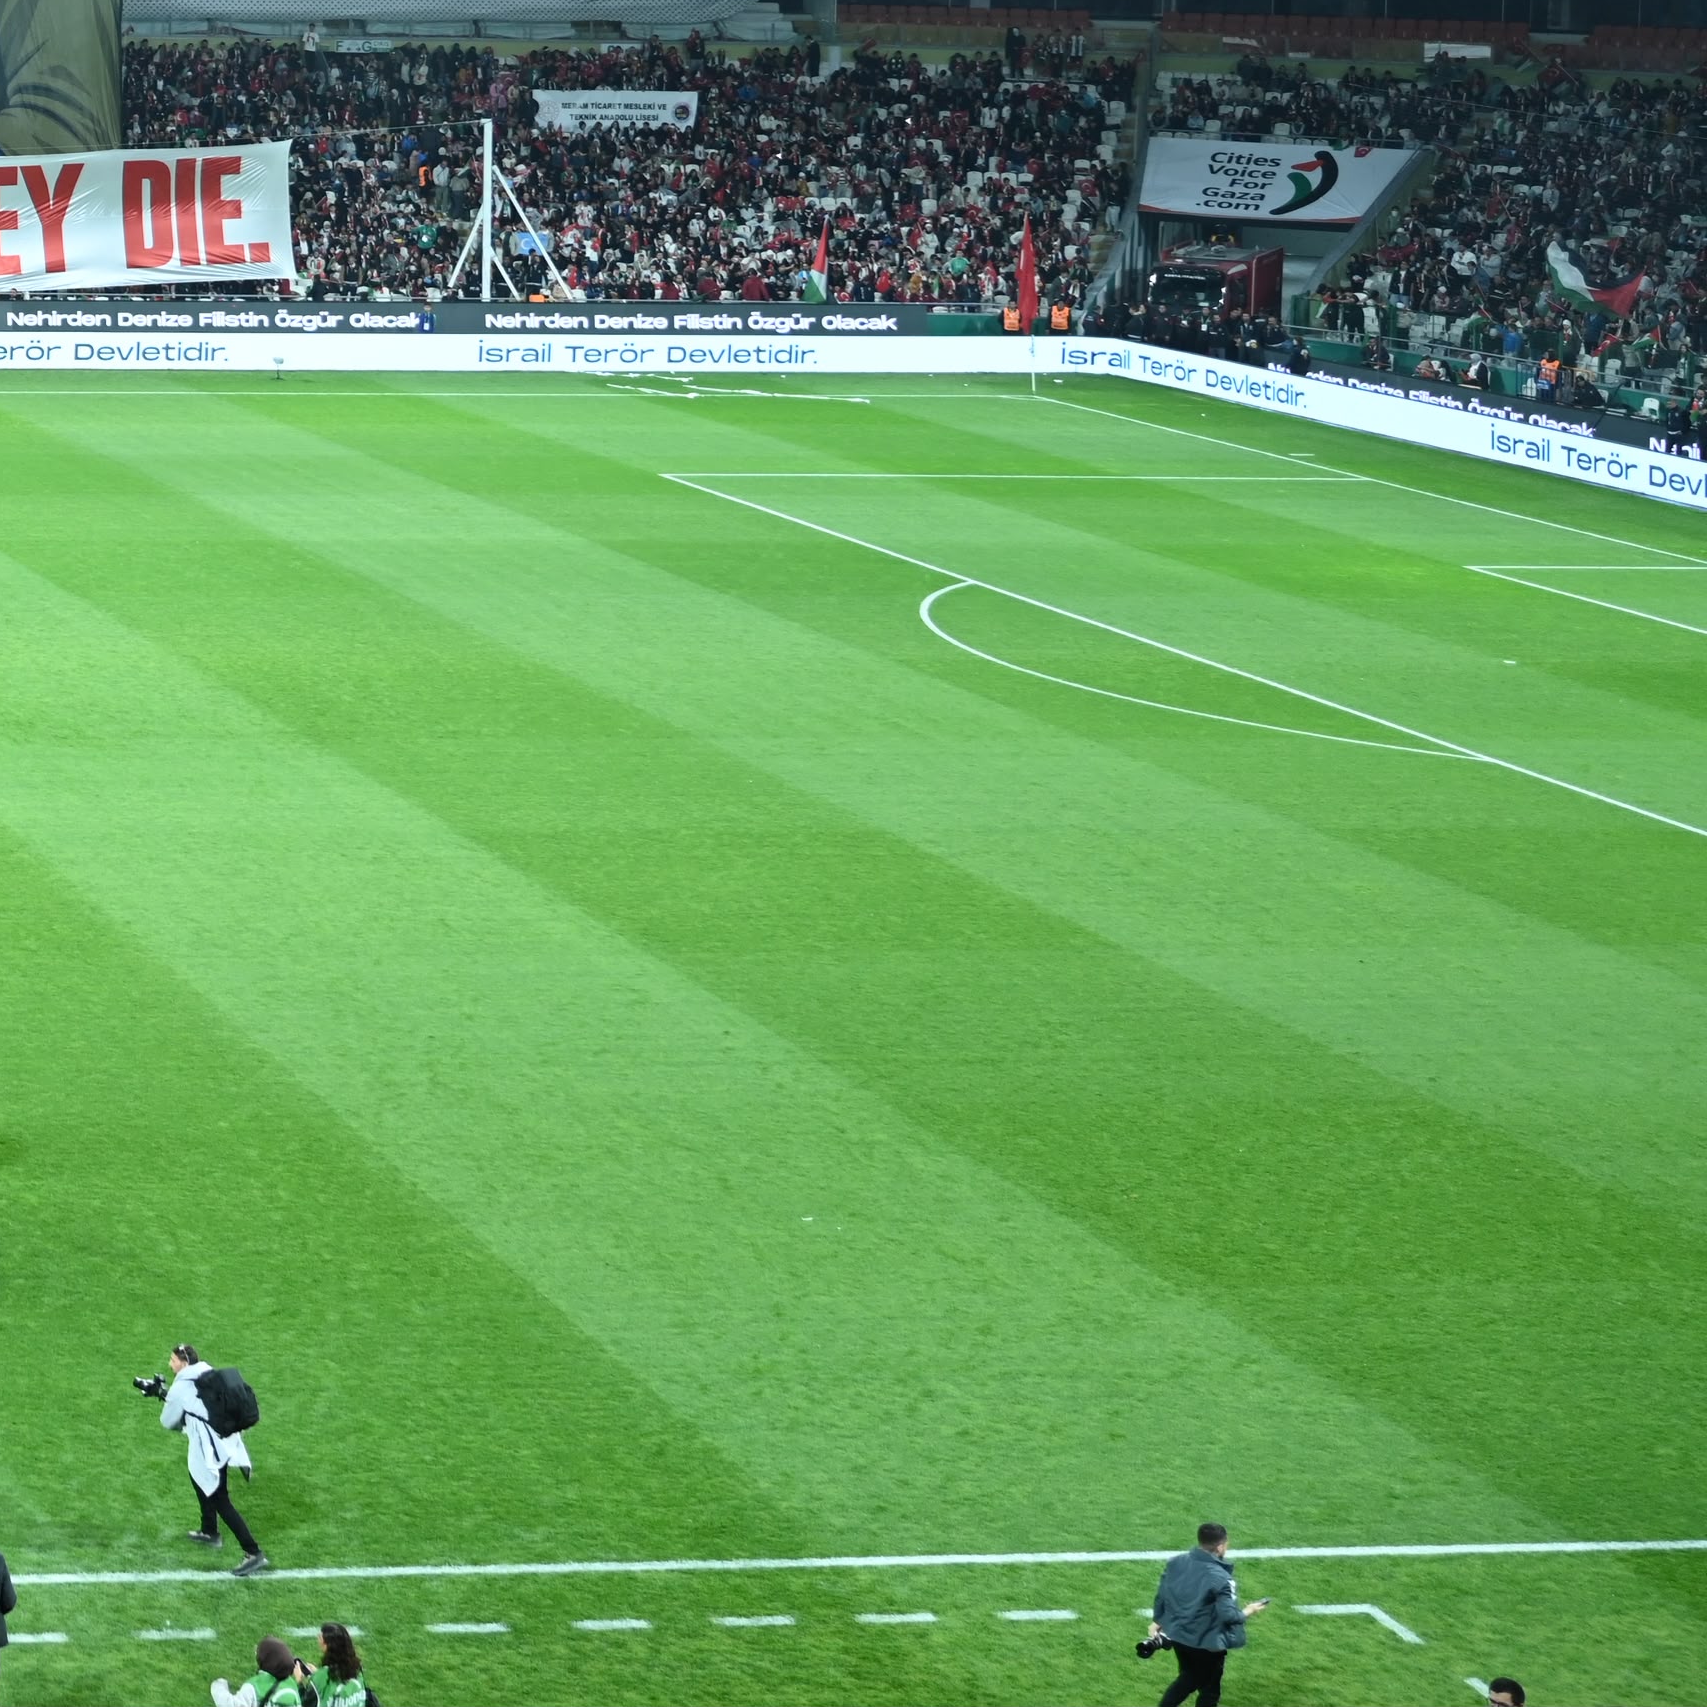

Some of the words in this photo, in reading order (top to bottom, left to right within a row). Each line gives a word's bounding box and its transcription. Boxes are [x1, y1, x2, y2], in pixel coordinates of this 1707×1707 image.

[589, 101, 622, 111] TİCARET
[624, 101, 656, 111] MESLEKİ
[657, 103, 668, 111] VE
[570, 112, 597, 122] TEKNİK
[599, 113, 634, 122] ANADOLU
[1209, 151, 1282, 168] Cities
[1207, 163, 1277, 181] Voice
[1201, 186, 1267, 202] Gaza
[1228, 178, 1274, 191] For
[120, 156, 272, 269] DIE.
[1195, 199, 1261, 213] .com
[6, 310, 112, 327] Nehirden
[117, 311, 193, 327] Denize
[198, 311, 269, 327] Filistin
[274, 309, 344, 332] Özgür
[485, 312, 589, 329] Nehirden
[594, 313, 668, 329] Denize
[673, 313, 743, 330] Filistin
[747, 311, 816, 334] Özgür
[821, 314, 897, 330] Olacak
[74, 341, 228, 362] Devletidir.
[565, 342, 654, 364] Terör
[667, 344, 817, 364] Devletidir.
[1138, 354, 1194, 385] Terör
[1204, 364, 1308, 409] Devletidir.
[1560, 445, 1639, 481] Terör
